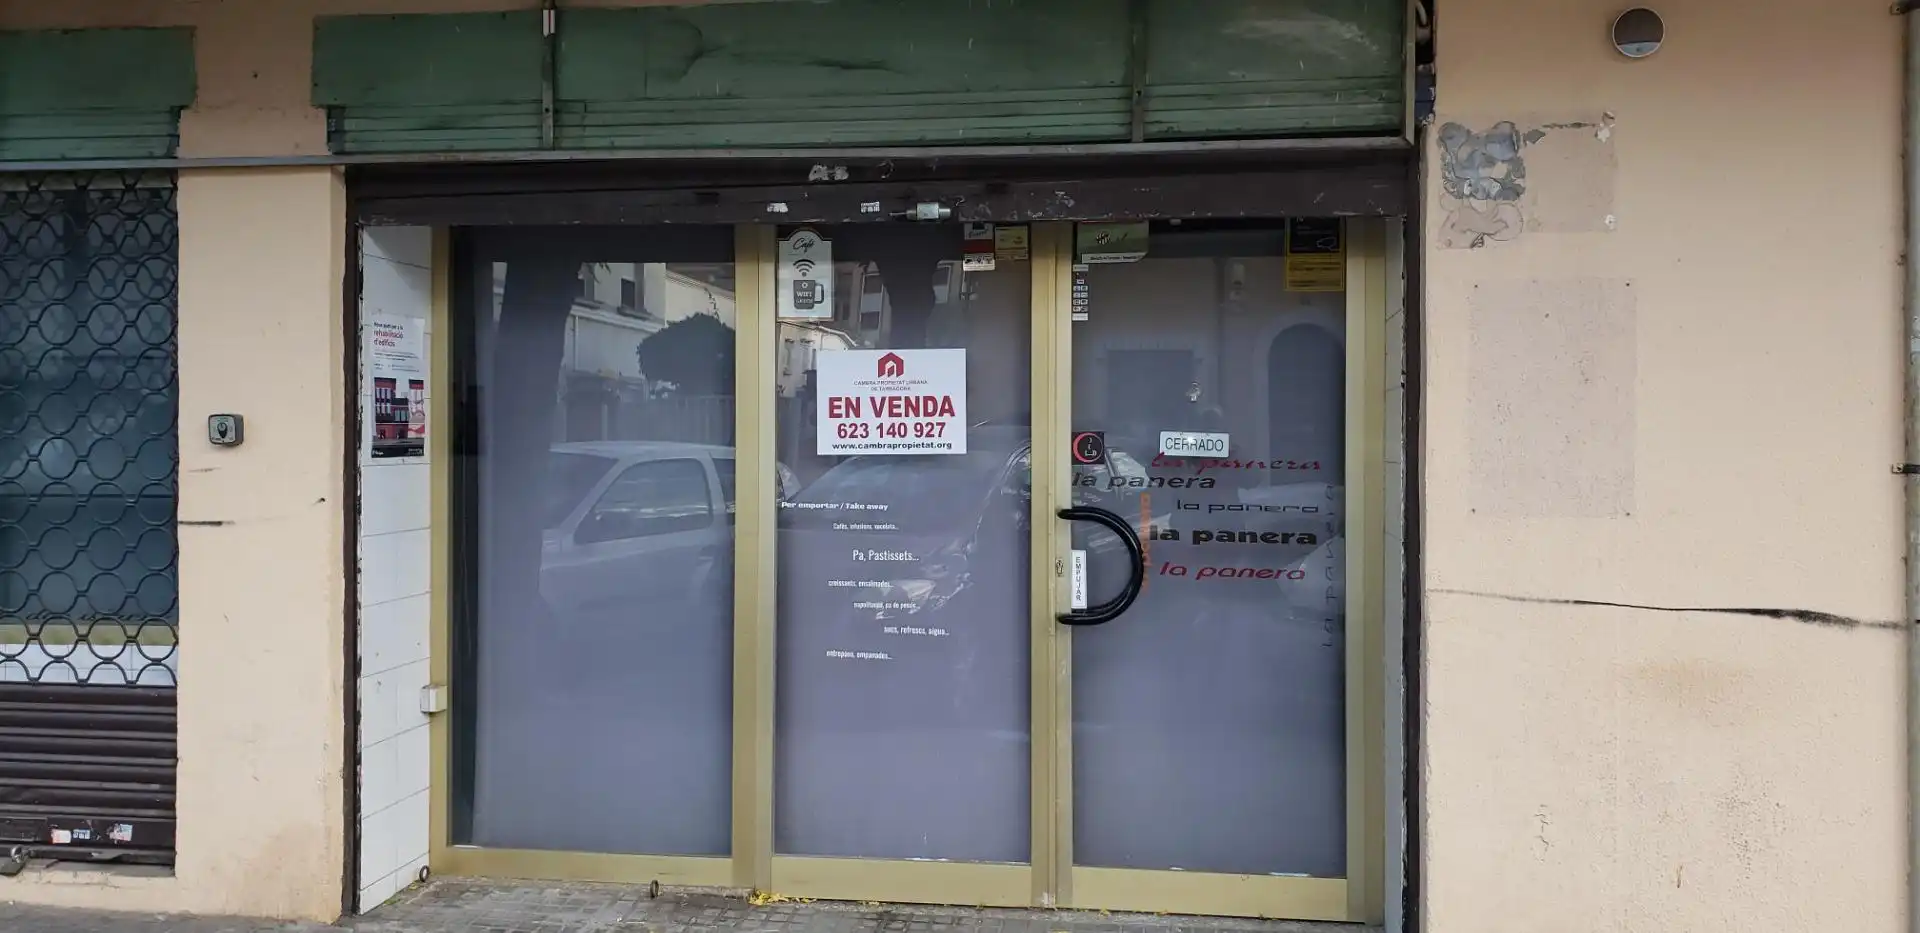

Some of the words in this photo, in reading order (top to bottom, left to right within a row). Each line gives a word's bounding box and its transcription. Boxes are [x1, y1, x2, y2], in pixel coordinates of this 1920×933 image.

[828, 396, 861, 419] EN
[869, 395, 956, 418] VENDA
[837, 423, 869, 439] 623
[876, 422, 908, 439] 140
[913, 422, 946, 438] 927
[832, 442, 953, 450] www.cambrapropietat.org
[1165, 437, 1225, 452] CERRADO
[1196, 459, 1321, 475] panera
[1071, 472, 1096, 487] la
[1107, 475, 1216, 489] panera
[798, 502, 839, 510] emportar
[1176, 500, 1200, 511] la
[1208, 503, 1319, 514] panera
[1150, 525, 1180, 541] la
[1192, 530, 1318, 546] panera
[852, 550, 867, 562] Pa,
[868, 550, 919, 562] Pastissets...
[1160, 561, 1186, 576] la
[1196, 565, 1306, 580] panera
